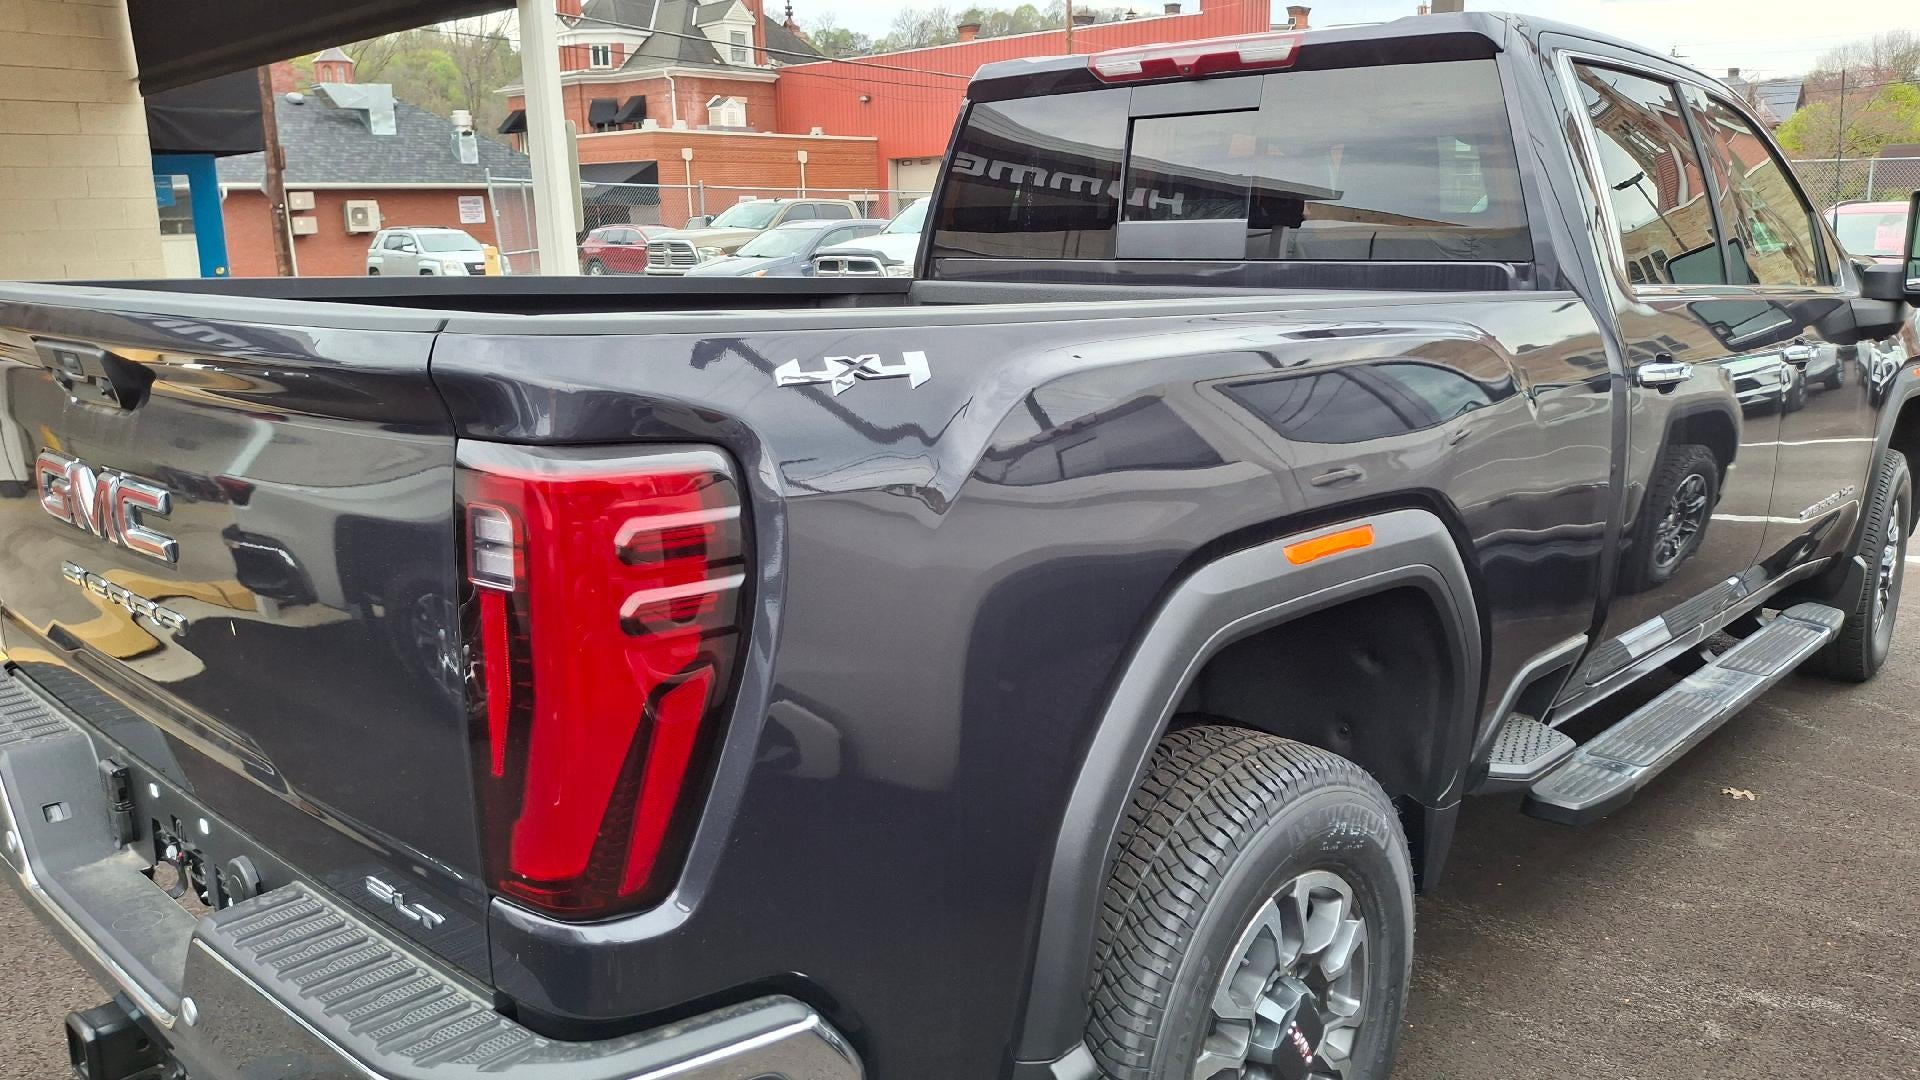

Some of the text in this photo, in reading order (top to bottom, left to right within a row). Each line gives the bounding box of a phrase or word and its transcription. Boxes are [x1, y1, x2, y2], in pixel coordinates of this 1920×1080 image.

[36, 449, 179, 563] GMC
[61, 559, 189, 636] SIERRA
[365, 875, 446, 930] SLT
